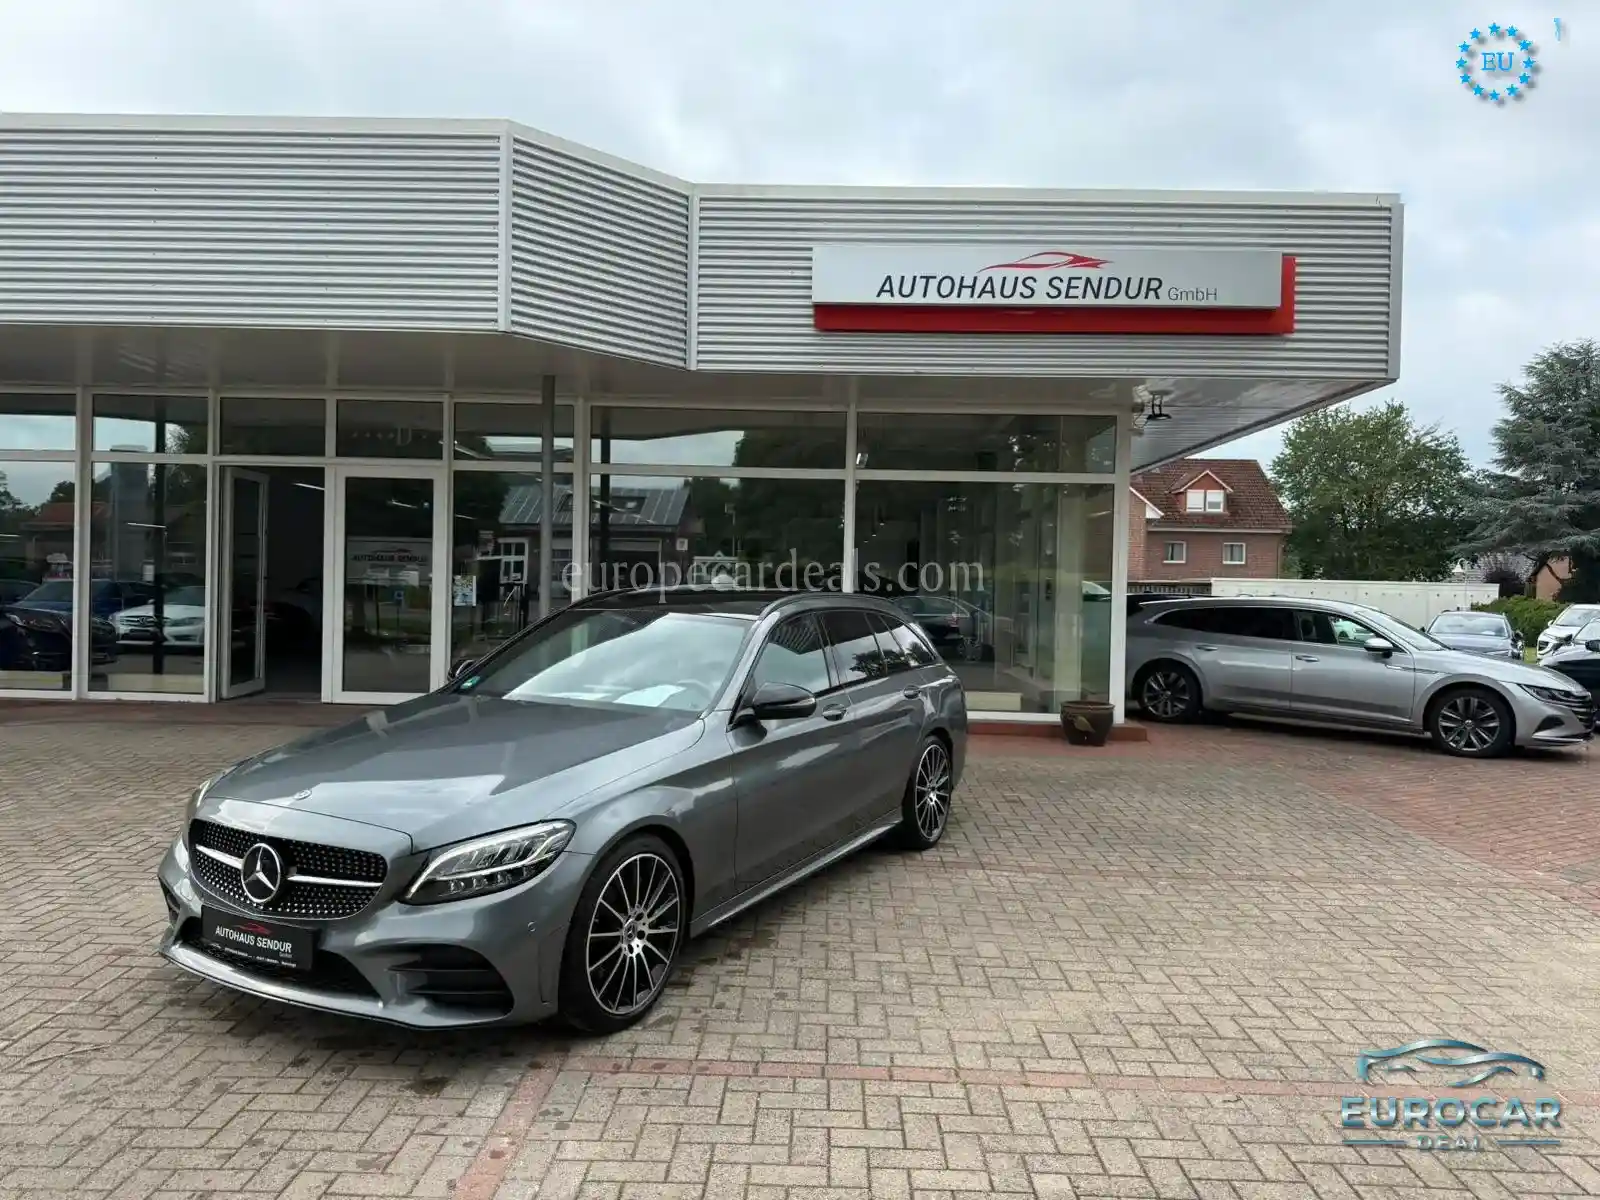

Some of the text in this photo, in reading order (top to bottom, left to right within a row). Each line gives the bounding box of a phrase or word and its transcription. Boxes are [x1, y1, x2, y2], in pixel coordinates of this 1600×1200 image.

[876, 275, 1218, 302] AUTOHAUS SENDUR GmbH
[215, 925, 293, 953] AUTOHAUS SENDUR
